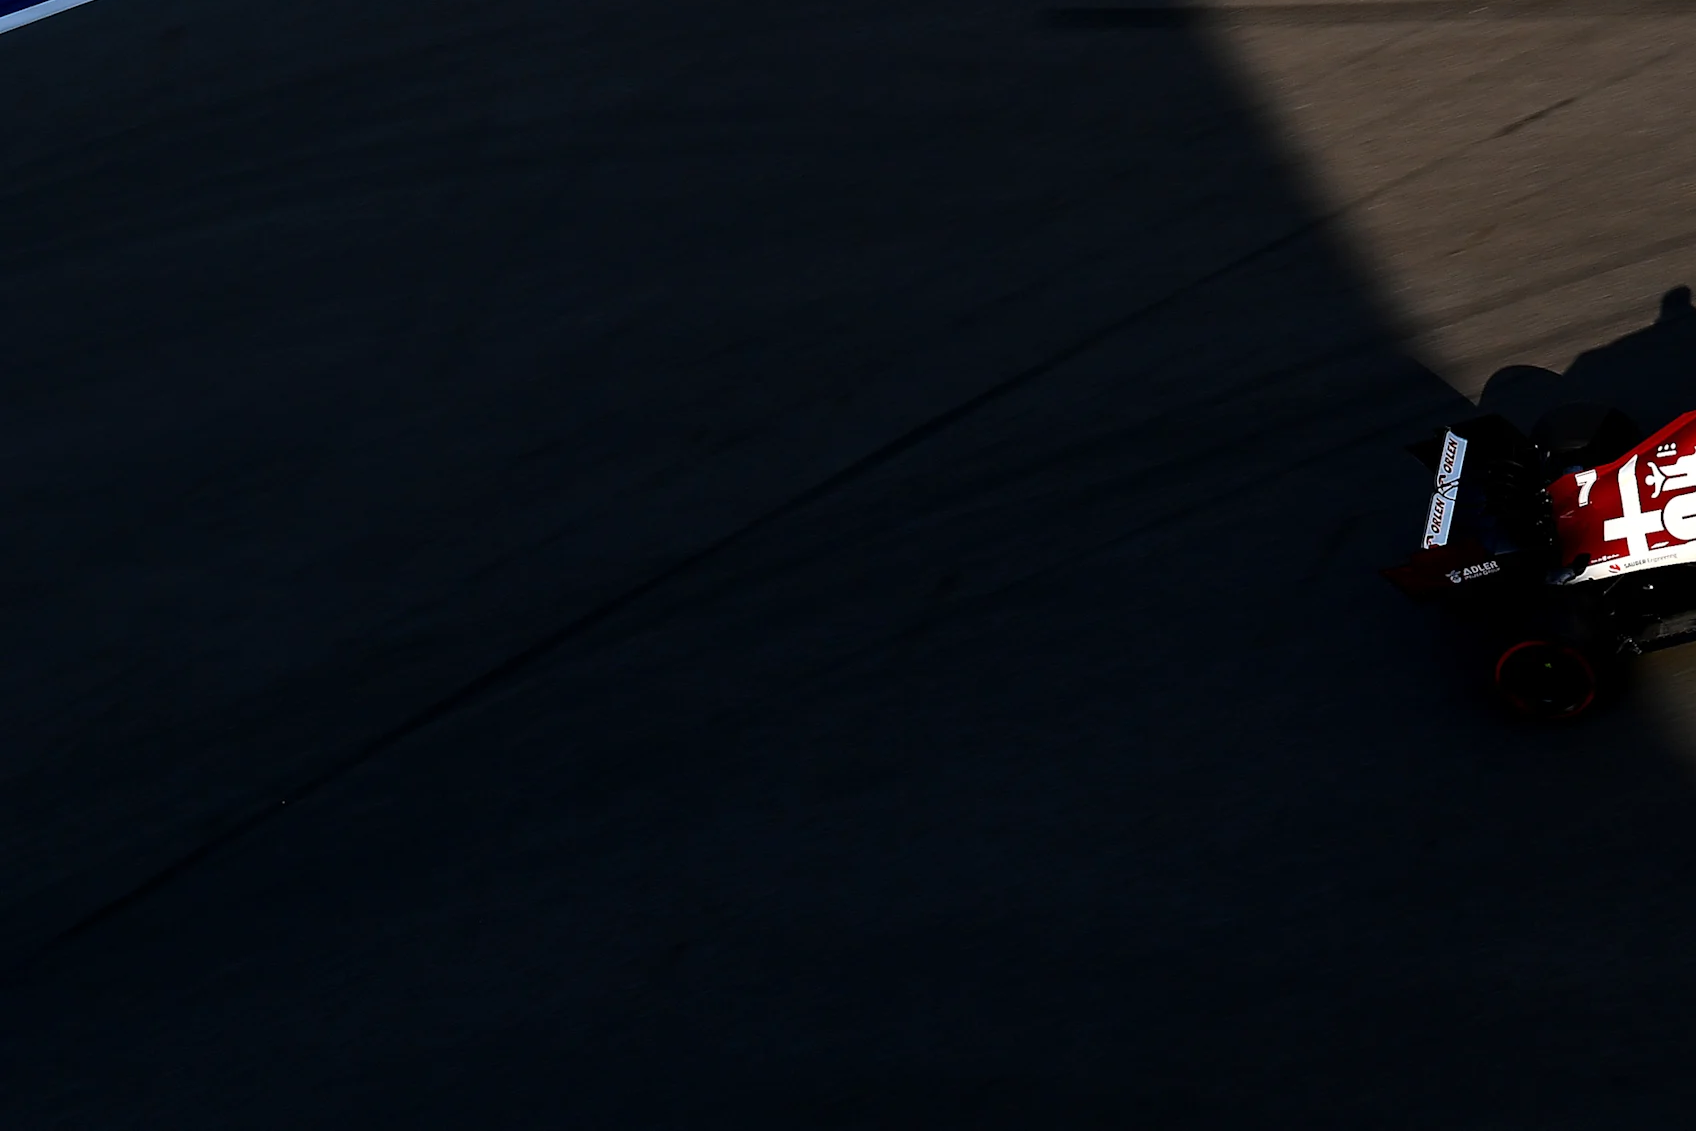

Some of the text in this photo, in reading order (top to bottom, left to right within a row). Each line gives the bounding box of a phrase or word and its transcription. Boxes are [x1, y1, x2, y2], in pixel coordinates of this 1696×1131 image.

[1444, 438, 1458, 474] ORLEN
[1575, 469, 1597, 508] 7
[1431, 498, 1446, 534] ORLEN
[1463, 560, 1498, 576] ADLER
